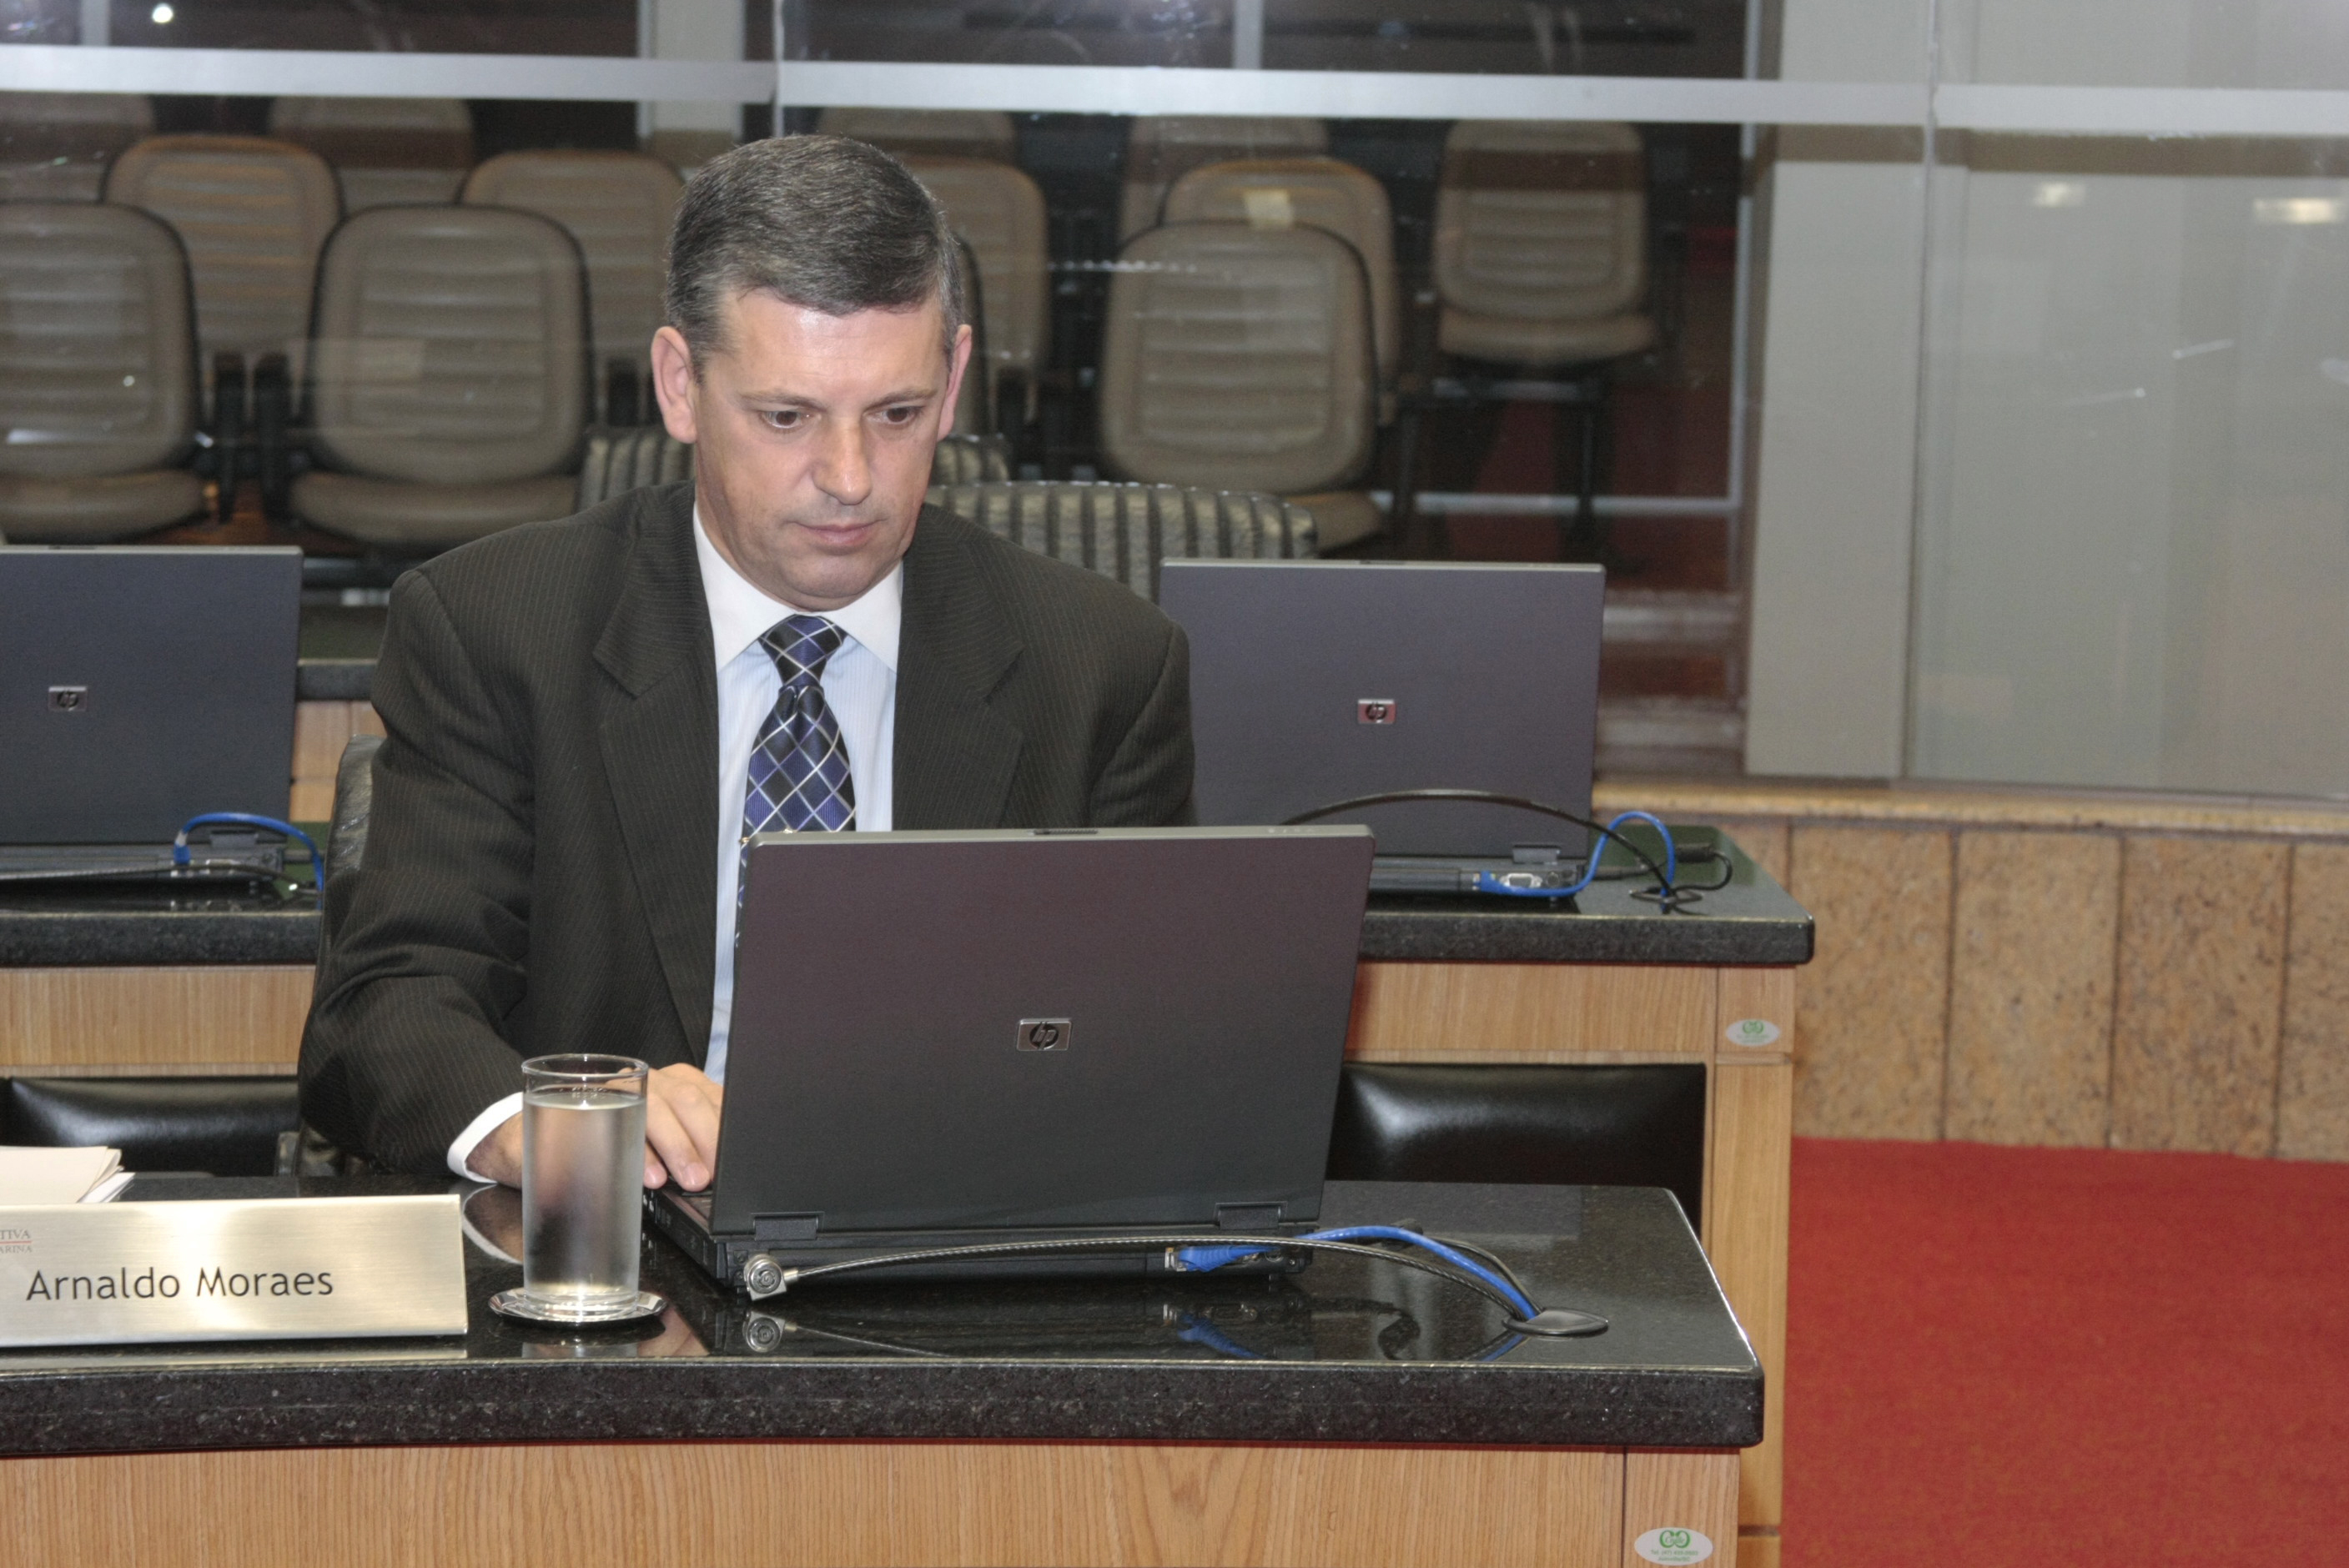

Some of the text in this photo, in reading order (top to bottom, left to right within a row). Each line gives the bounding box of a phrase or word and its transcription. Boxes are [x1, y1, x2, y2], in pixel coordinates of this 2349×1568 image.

[58, 688, 79, 710] hp
[1366, 701, 1387, 722] hp
[1030, 1022, 1059, 1049] hp
[26, 1267, 334, 1301] Arnaldo Moraes
